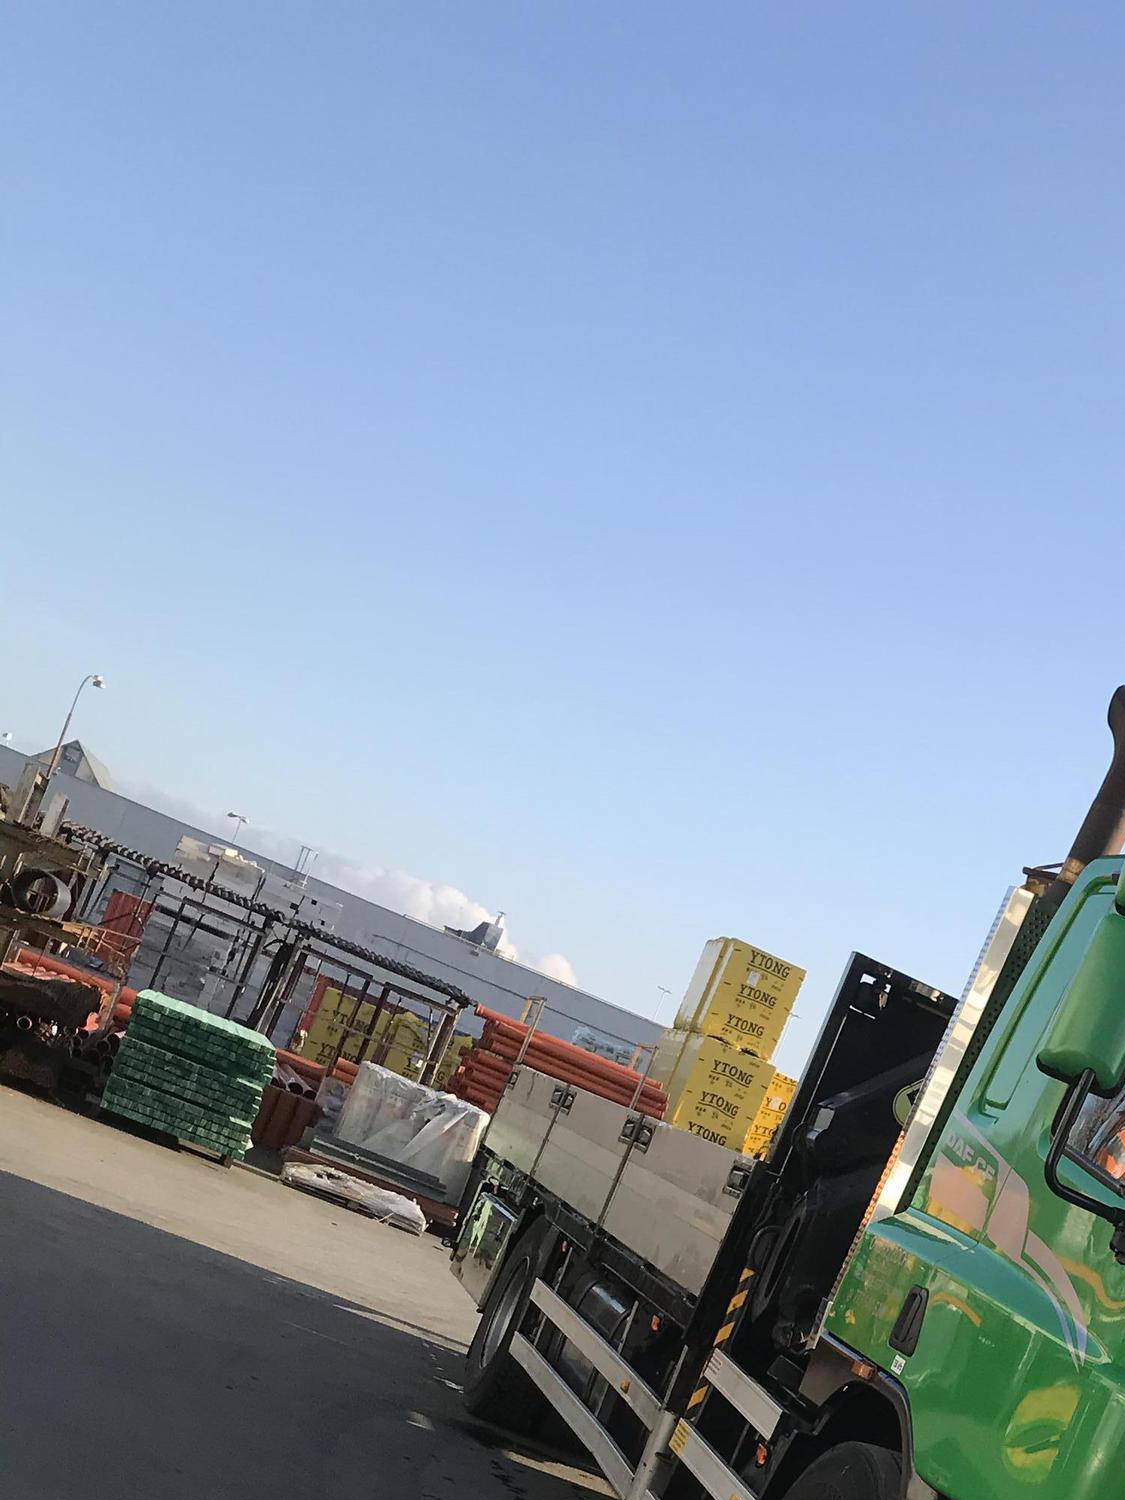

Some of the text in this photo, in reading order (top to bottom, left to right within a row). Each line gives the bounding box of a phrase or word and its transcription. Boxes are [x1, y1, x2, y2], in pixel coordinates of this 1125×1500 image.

[749, 949, 791, 978] YTONG
[738, 983, 777, 1008] YTONG
[726, 1013, 765, 1038] YTONG
[713, 1059, 754, 1085] YTONG
[700, 1090, 741, 1117] YTONG
[687, 1121, 727, 1147] YTONG
